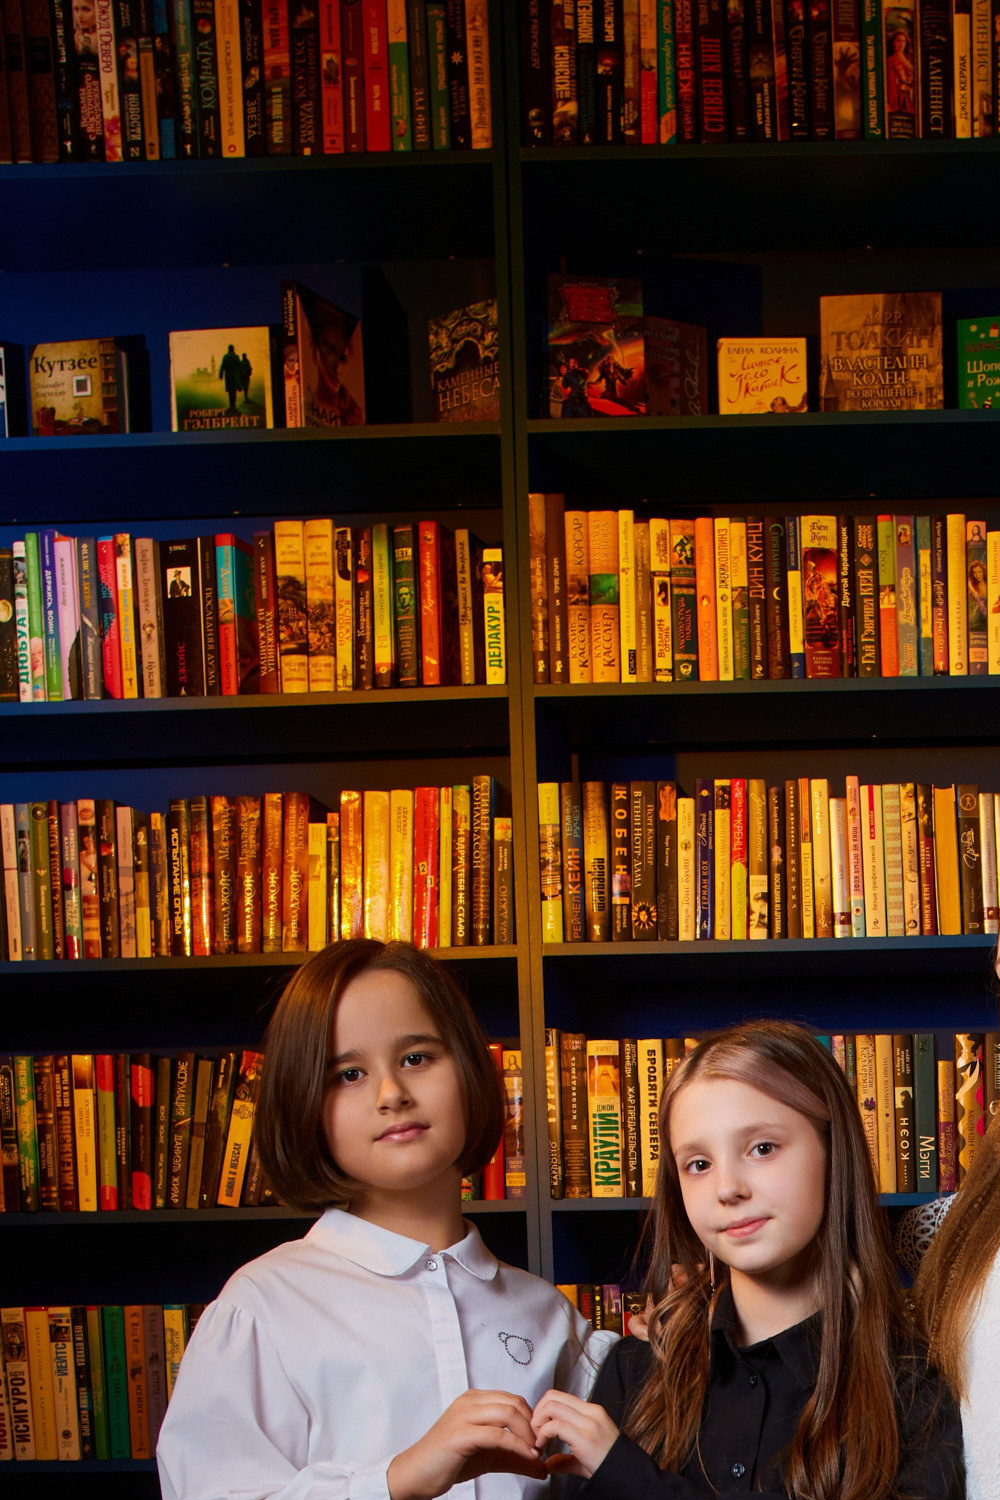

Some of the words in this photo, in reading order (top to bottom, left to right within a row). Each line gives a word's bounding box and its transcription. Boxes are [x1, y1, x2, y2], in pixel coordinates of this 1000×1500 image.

[554, 45, 570, 91] КЛЭНСИ
[700, 35, 721, 73] КИНГ
[702, 78, 724, 132] СТИВЕН
[929, 55, 943, 134] АЛИЕНИСТ
[128, 93, 142, 141] НОВОСТИ
[34, 356, 98, 377] Кутзее
[184, 415, 259, 430] ГЭЛБРЕЙТ
[718, 529, 728, 566] КОЛЛИНЗ
[750, 522, 764, 561] КУНЦ
[840, 527, 850, 576] барабанщик
[44, 570, 54, 607] ДЕРЖИСЬ,
[718, 566, 728, 589] ДЖЕКИ
[750, 566, 765, 599] ДИН
[840, 578, 850, 607] Другой
[46, 609, 55, 635] ВОИН!
[487, 606, 502, 668] ДЕЛАКУР
[17, 617, 29, 684] ДЮБУА
[176, 641, 188, 683] ДЖОЙС
[615, 790, 627, 874] КОБЕН
[564, 848, 579, 894] КЕЙН
[923, 883, 931, 900] КЕНТ
[572, 896, 581, 939] РЕЙЧЕЛ
[923, 903, 932, 930] МИНКА
[627, 1086, 635, 1102] ЖАР
[646, 1049, 657, 1108] БРОДЯГИ
[593, 1113, 621, 1186] КРАУЛИ
[627, 1105, 636, 1172] ПРЕДАТЕЛЬСТВА
[648, 1112, 659, 1161] СЕВЕРА
[900, 1117, 910, 1160] КОЭН
[10, 1377, 31, 1443] ИСИГУРО
